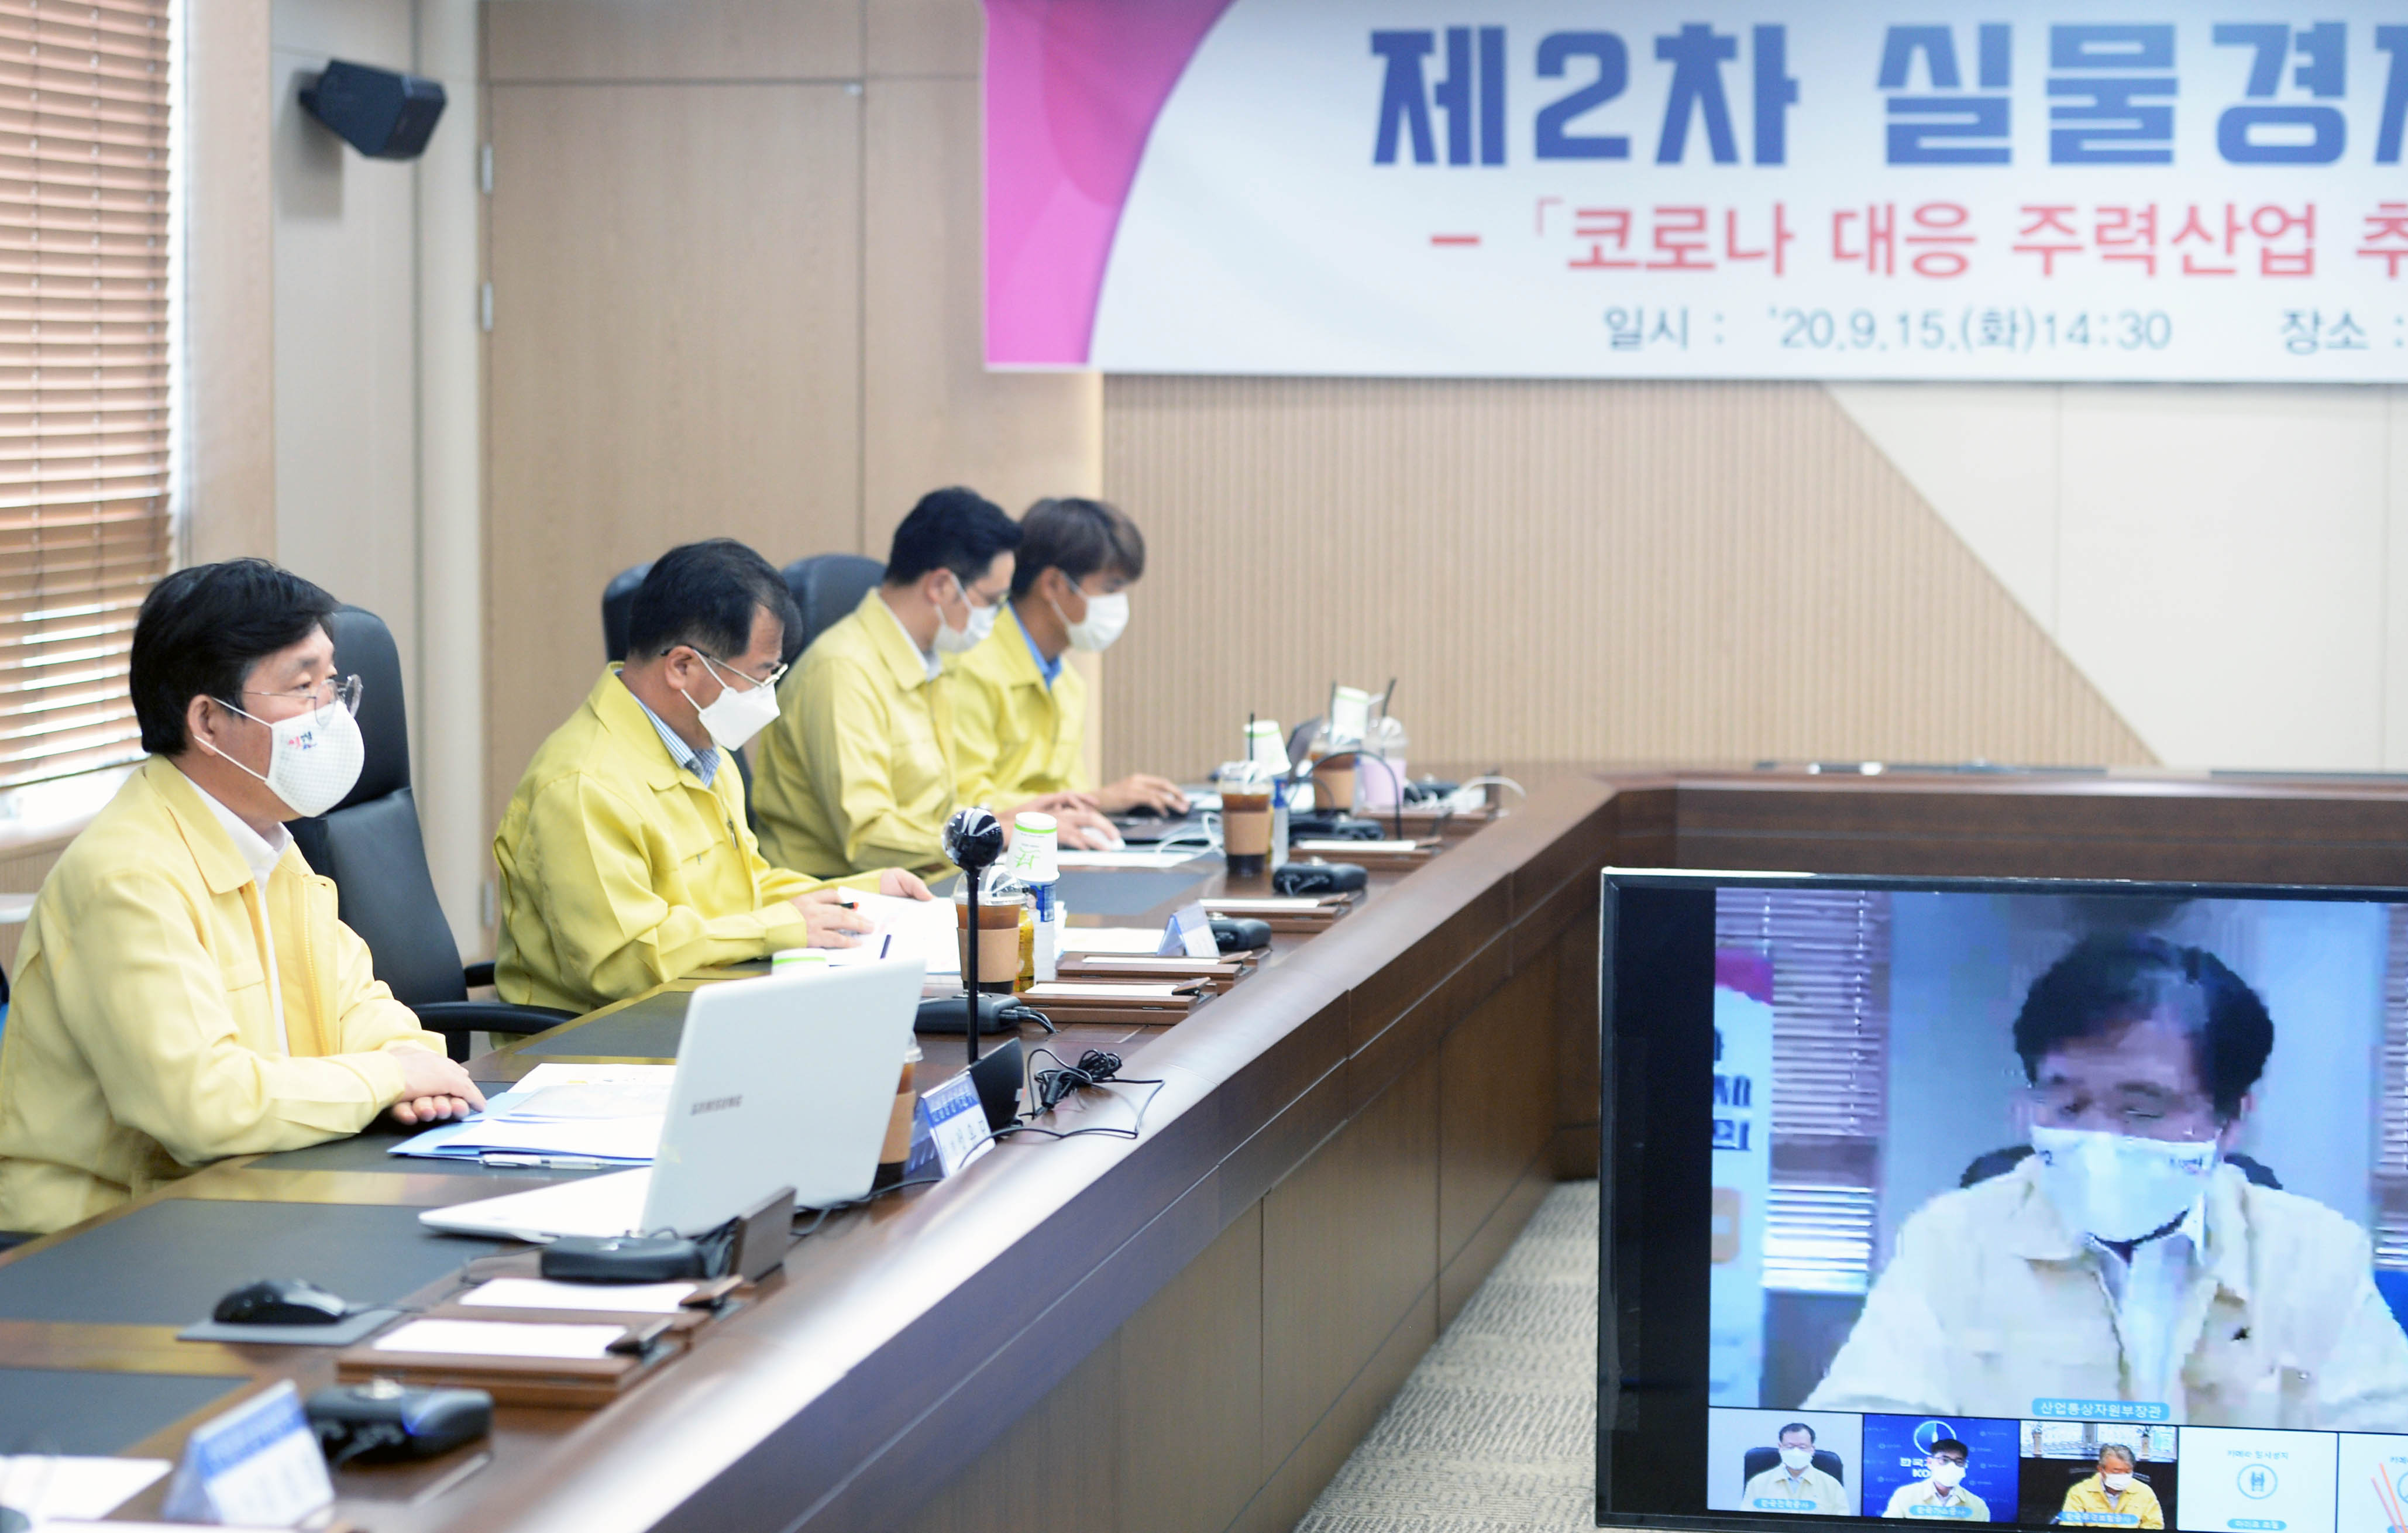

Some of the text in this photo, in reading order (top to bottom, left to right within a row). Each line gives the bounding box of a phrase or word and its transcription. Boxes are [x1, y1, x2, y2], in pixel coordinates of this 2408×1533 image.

[1370, 22, 1800, 166] 제2차
[1833, 202, 1977, 279] 대응
[2011, 202, 2315, 277] 주력산업
[1604, 307, 1690, 350] 일시
[2280, 308, 2369, 355] 장소
[690, 1095, 742, 1115] SAMSUNG
[2041, 1402, 2162, 1419] 산업통상자원부장관
